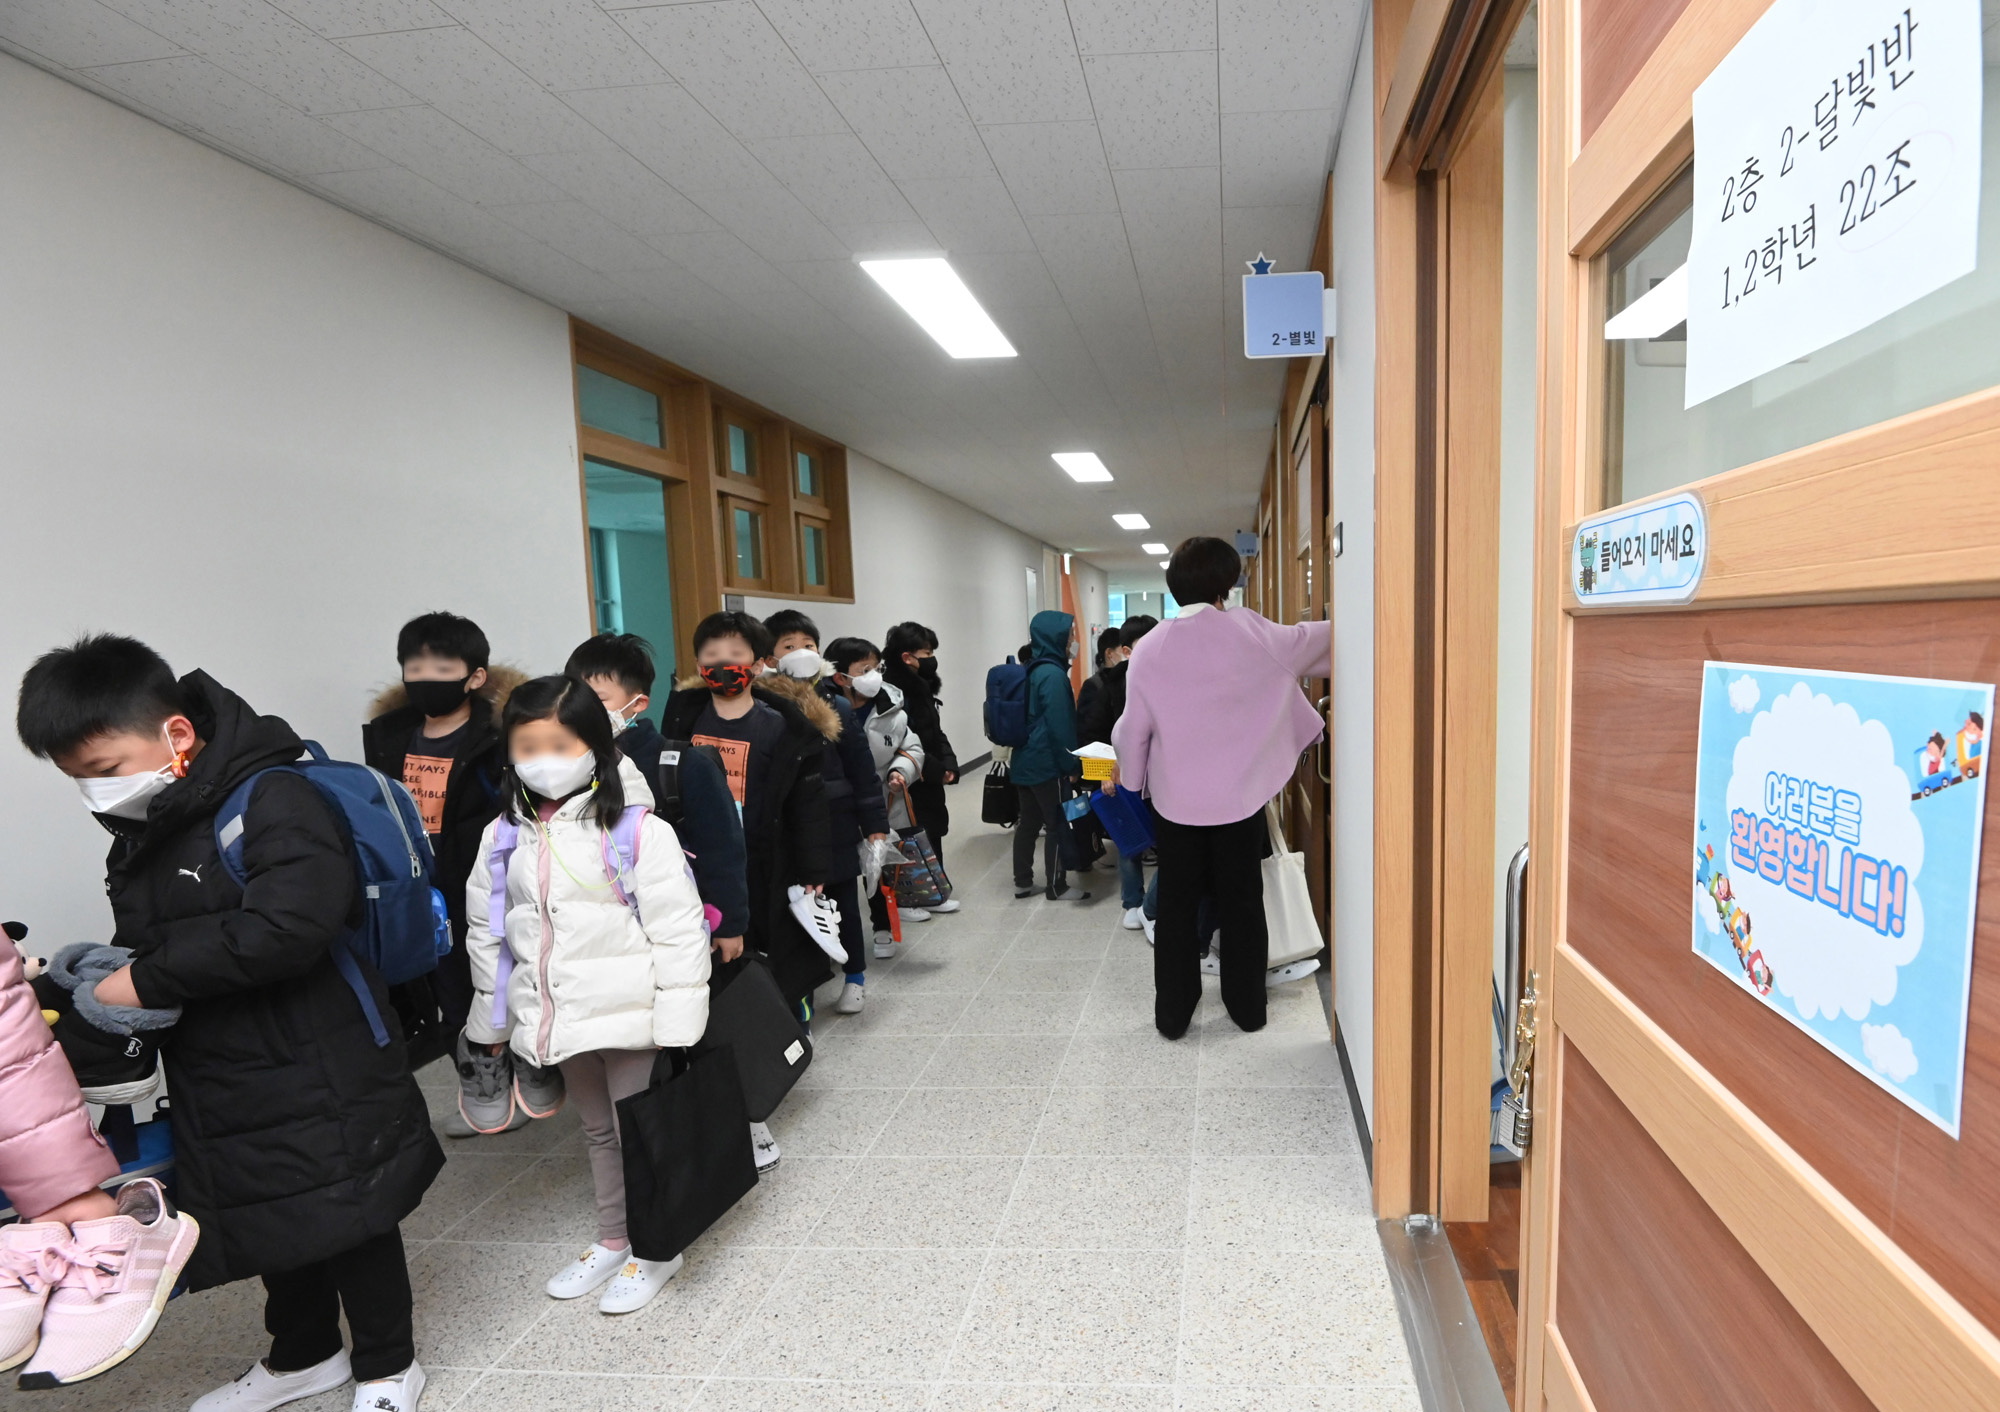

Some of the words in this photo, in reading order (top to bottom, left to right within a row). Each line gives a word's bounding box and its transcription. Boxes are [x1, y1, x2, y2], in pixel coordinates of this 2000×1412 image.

[1721, 156, 1764, 223] 2층
[1780, 8, 1919, 178] 2-달빛반
[1721, 203, 1817, 310] 1,2학년
[1839, 139, 1917, 237] 22조
[1272, 330, 1316, 346] 2-별빛
[1600, 532, 1646, 573] 들어오지
[1650, 523, 1696, 564] 마세요
[1765, 771, 1862, 847] 여러분을
[1731, 808, 1908, 939] 환영합니다!
